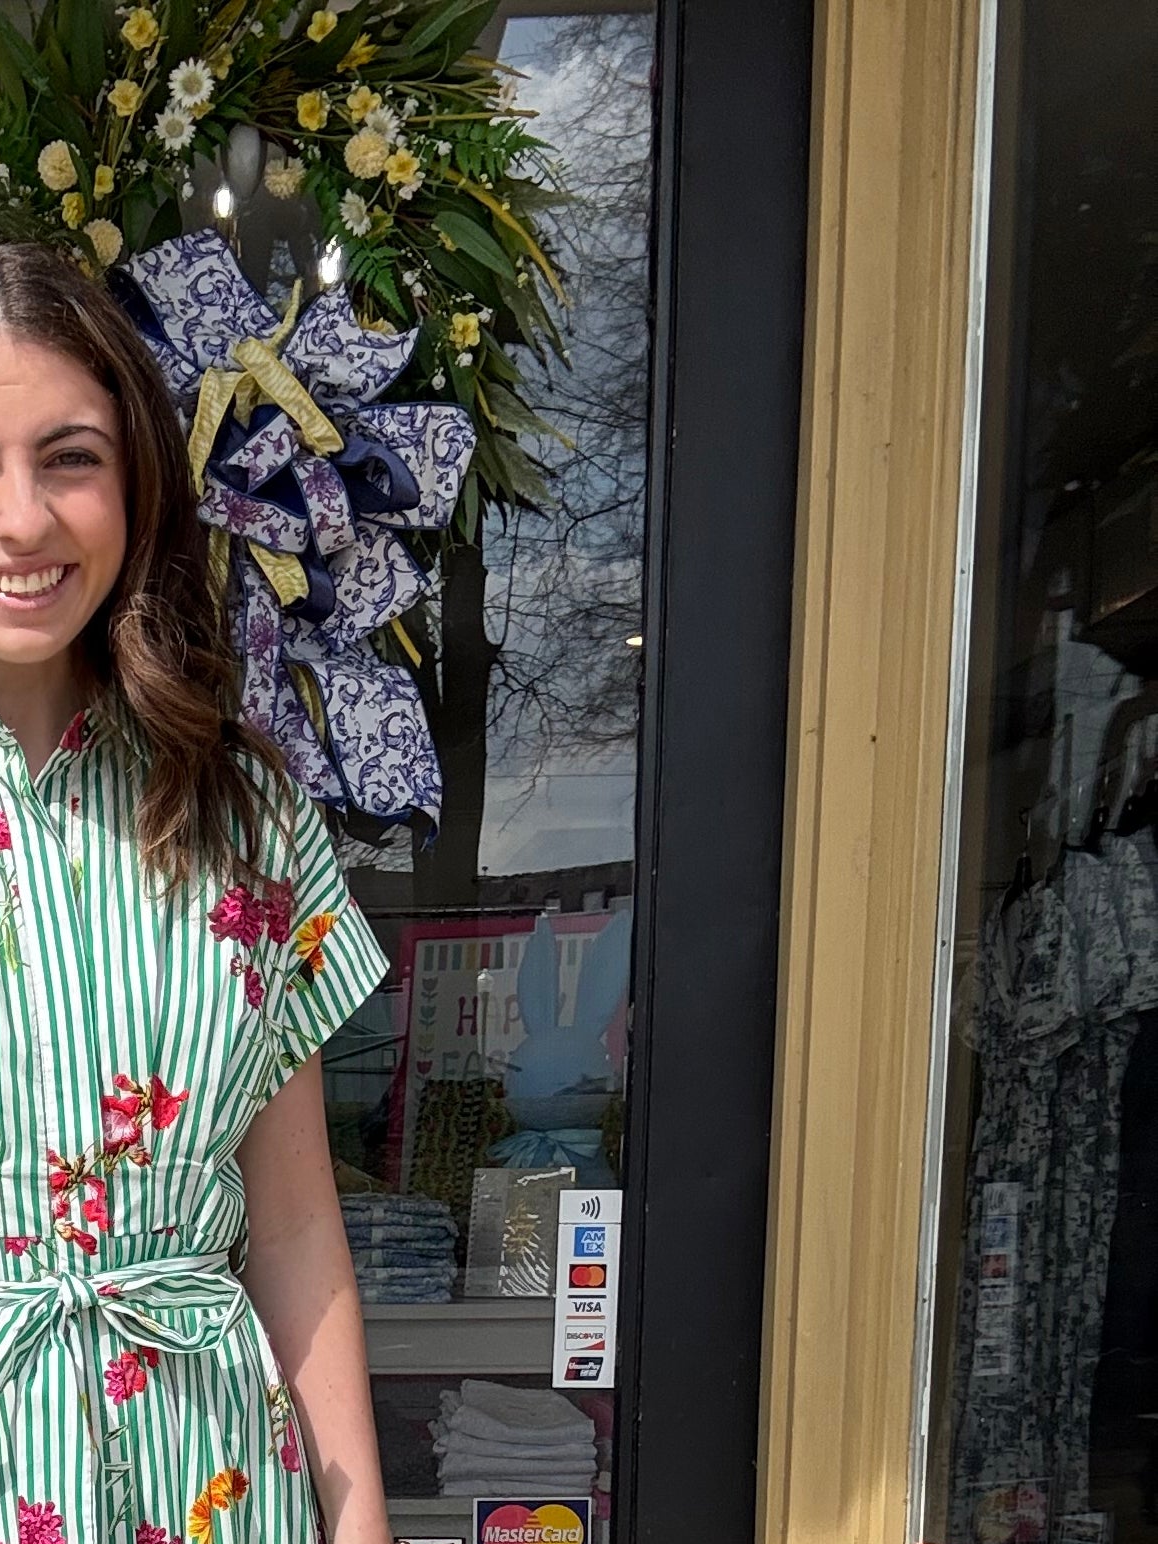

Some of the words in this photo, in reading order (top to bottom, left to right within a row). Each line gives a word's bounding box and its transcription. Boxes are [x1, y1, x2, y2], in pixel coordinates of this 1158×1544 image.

[584, 1232, 606, 1242] AM
[585, 1242, 605, 1252] EX
[572, 1301, 602, 1313] VISA
[566, 1332, 604, 1340] DISCOVER
[484, 1525, 581, 1544] MasterCard
